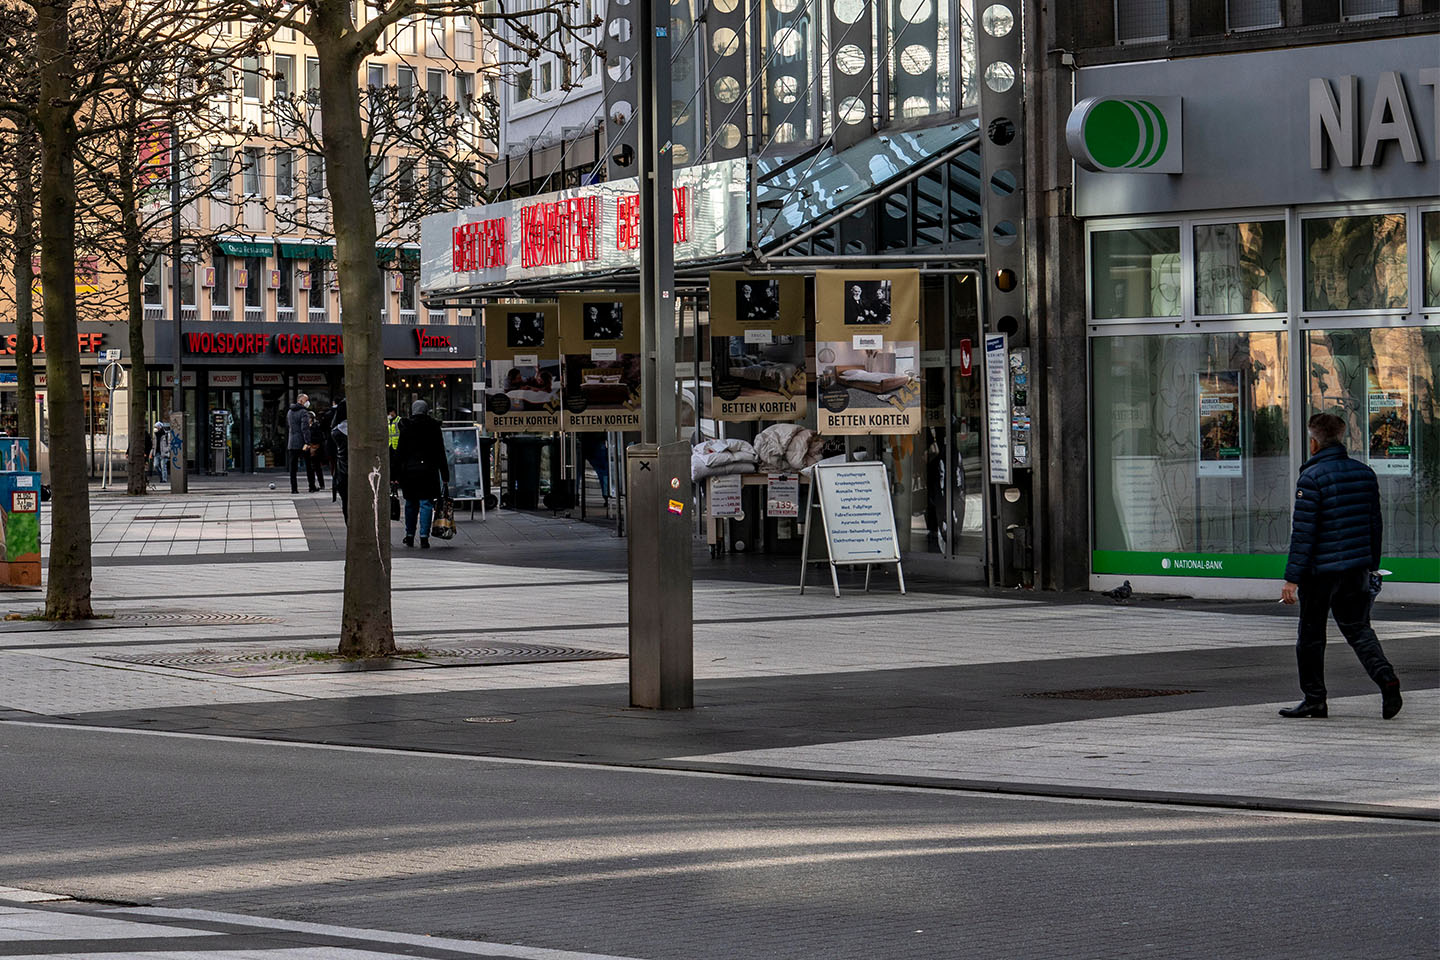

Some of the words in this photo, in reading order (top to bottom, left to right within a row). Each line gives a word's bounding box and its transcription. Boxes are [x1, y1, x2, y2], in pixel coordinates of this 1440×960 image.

[452, 216, 506, 273] BETTEN
[520, 195, 597, 269] KORTEN
[188, 332, 271, 353] WOLSDORFF
[722, 403, 757, 413] BETTEN
[760, 402, 797, 412] KORTEN
[494, 416, 524, 426] BETTEN
[526, 416, 558, 426] KORTEN
[570, 415, 602, 425] BETTEN
[605, 414, 639, 425] KORTEN
[828, 415, 866, 426] BETTEN
[869, 415, 910, 426] KORTEN
[1174, 560, 1223, 569] NATIONAL-BANK
